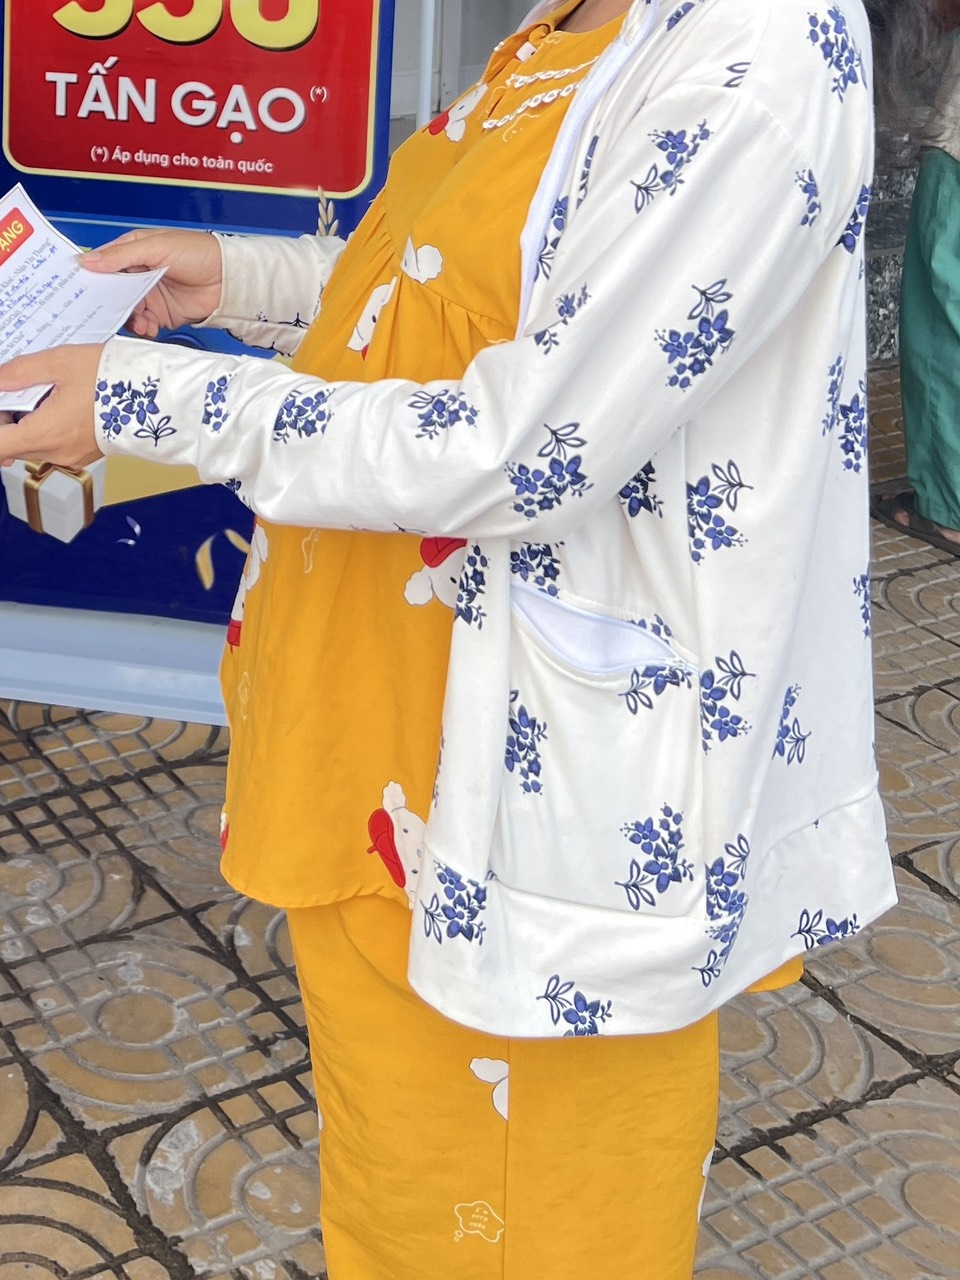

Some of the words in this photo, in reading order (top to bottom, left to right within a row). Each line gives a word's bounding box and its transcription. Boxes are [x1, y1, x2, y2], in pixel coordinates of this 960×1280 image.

[45, 56, 157, 124] TẤN
[171, 81, 306, 144] GẠO
[112, 144, 130, 164] Áp
[134, 150, 169, 167] dụng
[173, 152, 198, 167] cho
[202, 153, 233, 170] toàn
[237, 157, 274, 174] quốc
